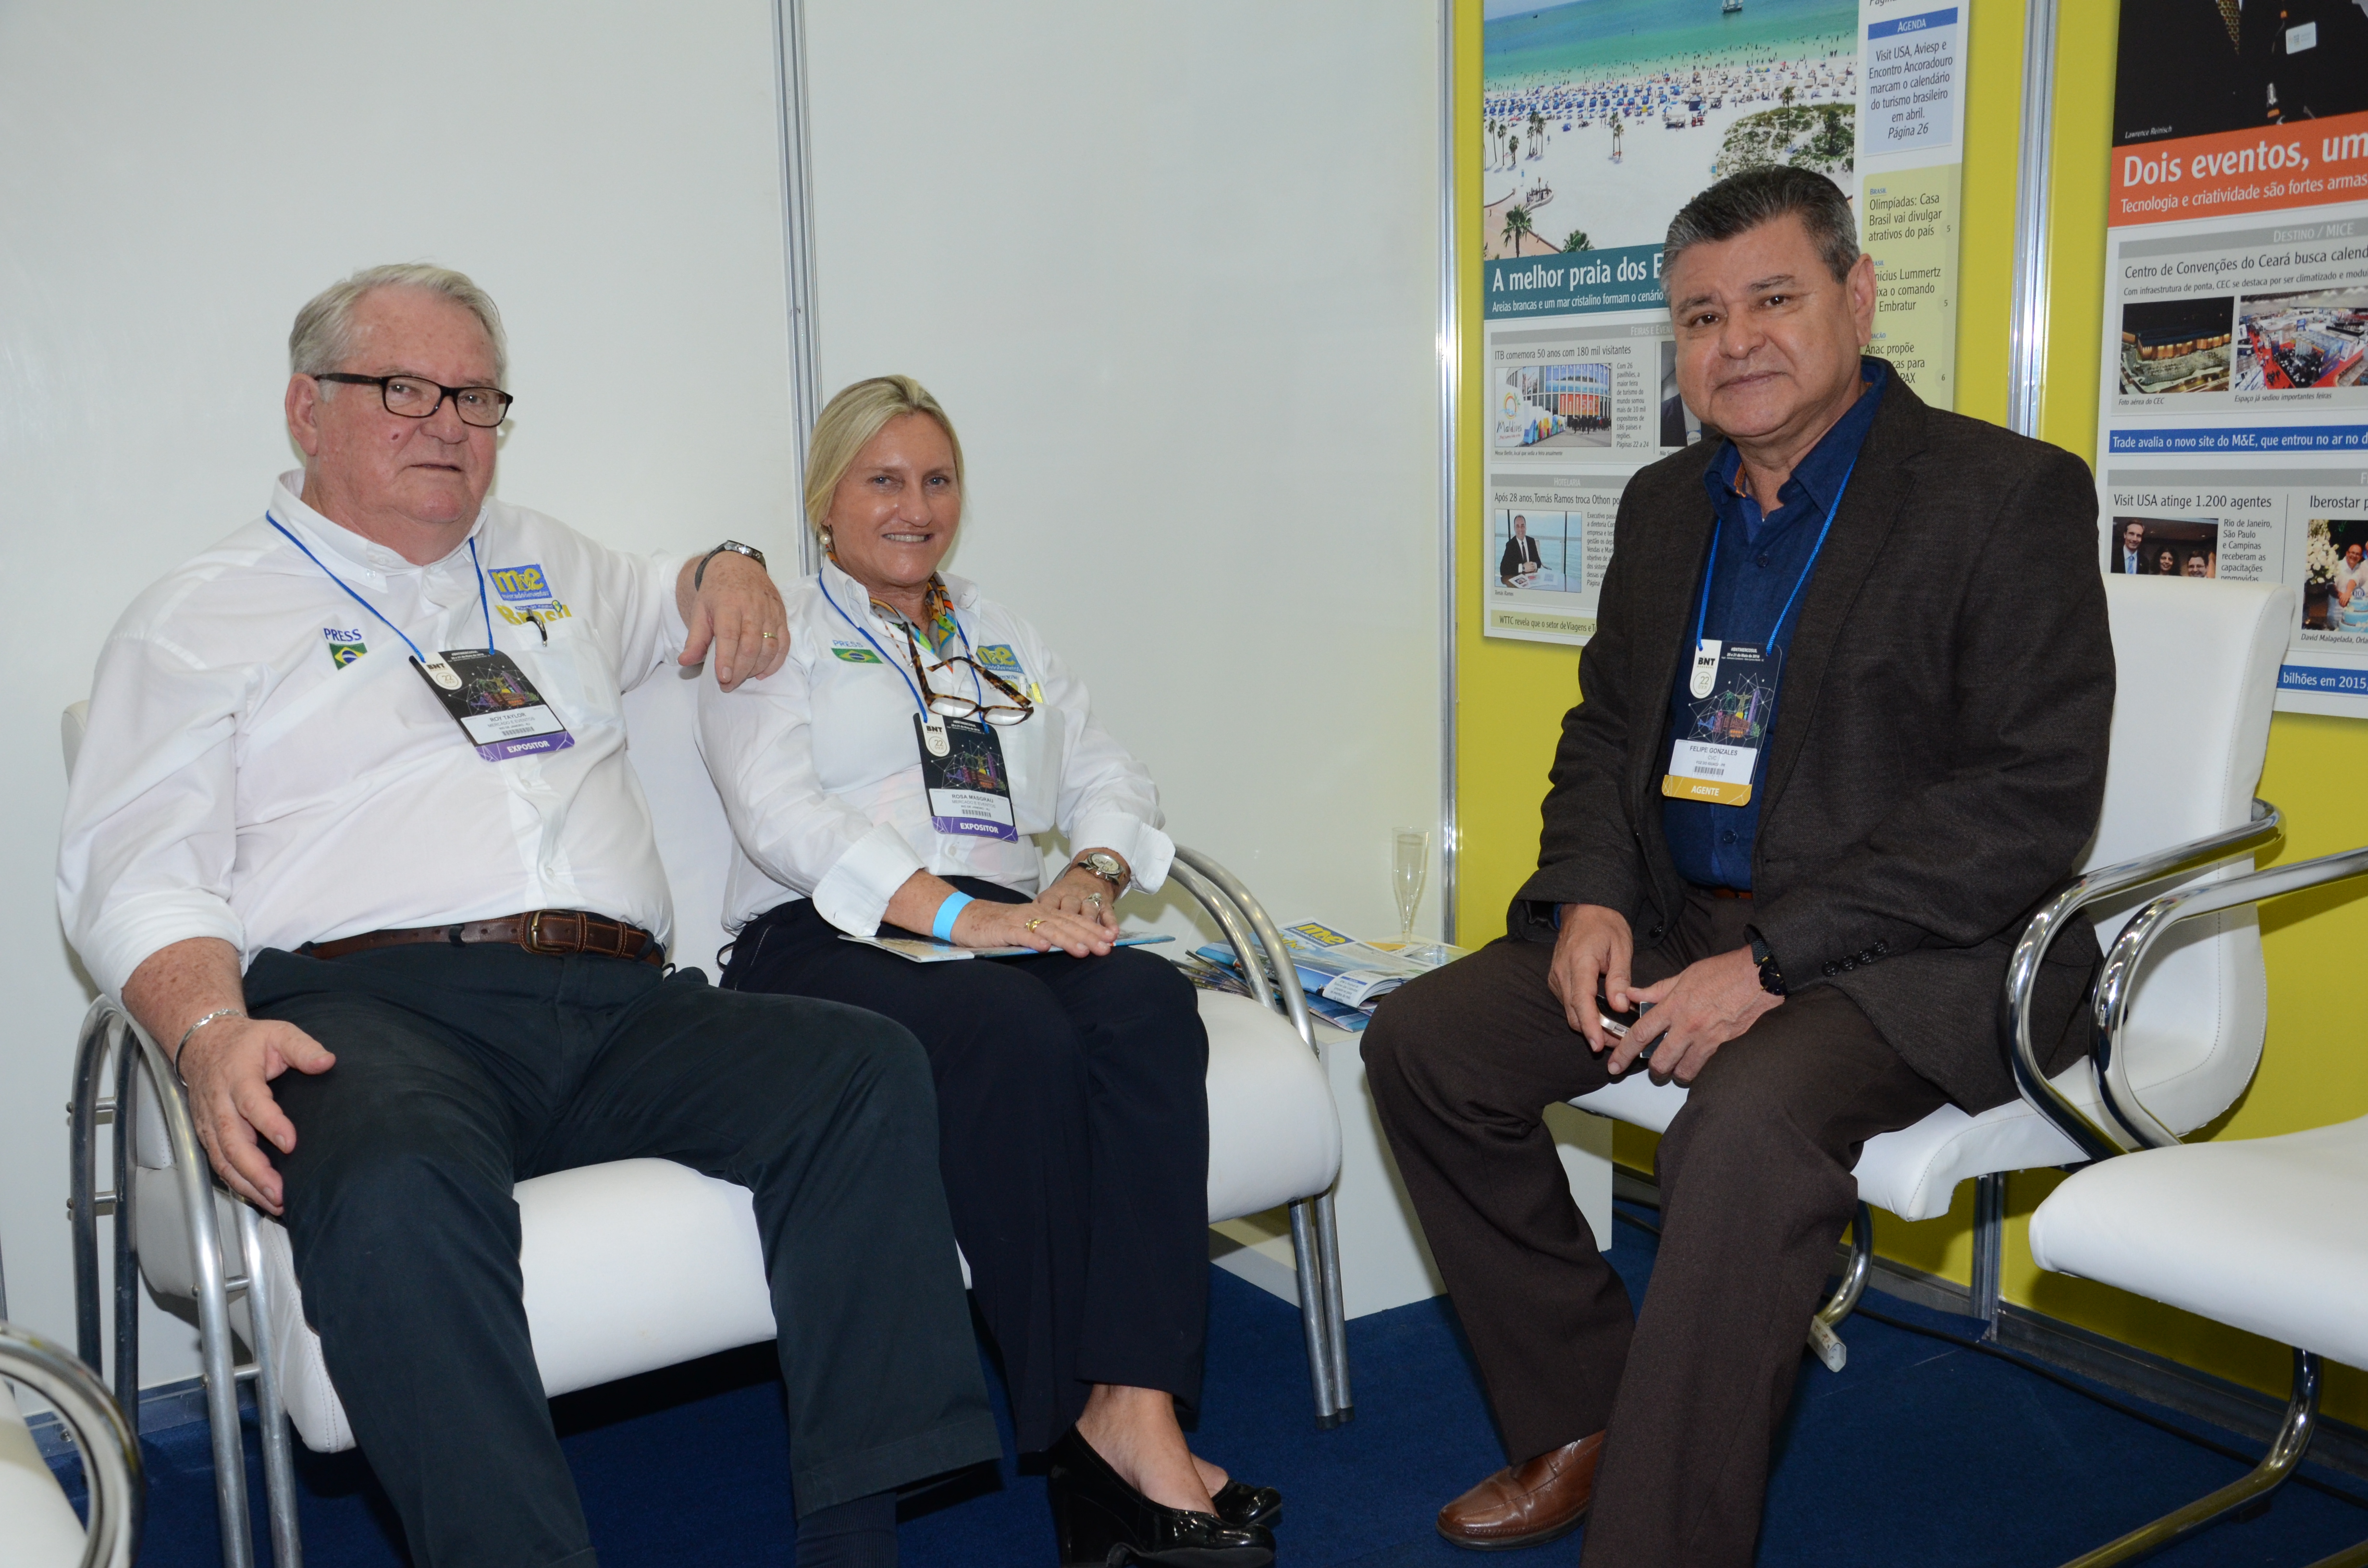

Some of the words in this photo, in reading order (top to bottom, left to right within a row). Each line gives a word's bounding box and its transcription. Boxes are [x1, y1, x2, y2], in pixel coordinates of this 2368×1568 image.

[1898, 19, 1926, 32] AGENDA
[1876, 49, 1891, 61] Visit
[1894, 46, 1912, 59] USA,
[1914, 42, 1939, 55] Aviesp
[1869, 65, 1901, 79] Encontro
[1904, 57, 1953, 73] Ancoradouro
[1871, 82, 1900, 95] marcam
[1911, 72, 1950, 88] calendário
[1871, 99, 1880, 110] do
[1883, 95, 1910, 108] turismo
[1913, 90, 1948, 103] brasileiro
[1892, 112, 1903, 122] em
[1906, 108, 1925, 121] abril.
[1888, 126, 1914, 140] Página
[1917, 123, 1929, 135] 26
[2123, 152, 2182, 187] Dois
[2191, 140, 2309, 179] eventos,
[2121, 195, 2178, 213] Tecnologia
[2192, 184, 2259, 206] criatividade
[2263, 182, 2284, 197] são
[2289, 179, 2323, 195] fortes
[2328, 174, 2367, 190] armas
[1870, 196, 1917, 211] Olimpíadas:
[1920, 193, 1939, 205] Casa
[1870, 213, 1890, 226] Brasil
[1894, 212, 1905, 223] vai
[1908, 209, 1942, 222] divulgar
[1869, 229, 1902, 241] atrativos
[1905, 227, 1914, 238] do
[1918, 224, 1934, 239] país
[2273, 229, 2314, 242] DESTINO
[2327, 222, 2354, 236] MICE
[2125, 266, 2157, 279] Centro
[2161, 263, 2172, 276] de
[2177, 258, 2237, 275] Convenções
[2242, 257, 2254, 269] do
[2259, 252, 2290, 267] Ceará
[2295, 252, 2326, 264] busca
[1492, 268, 1504, 292] A
[1510, 265, 1564, 290] melhor
[1570, 259, 1611, 291] praia
[1617, 257, 1646, 282] dos
[1900, 267, 1941, 280] Lummertz
[1898, 282, 1935, 295] comando
[2124, 288, 2137, 296] Com
[2140, 286, 2182, 294] infraestrutura
[2194, 283, 2214, 293] ponta,
[2217, 280, 2230, 289] CEC
[2242, 278, 2267, 287] destaca
[2270, 278, 2281, 286] por
[2296, 272, 2336, 283] climatizado
[1492, 301, 1511, 312] Areias
[1513, 300, 1537, 311] brancas
[1545, 300, 1554, 308] um
[1557, 298, 1570, 307] mar
[1572, 294, 1601, 306] cristalino
[1603, 293, 1629, 305] formam
[1638, 289, 1663, 302] cenário
[1879, 300, 1916, 312] Embratur
[1495, 351, 1504, 360] ITB
[1506, 351, 1535, 359] comemora
[1538, 349, 1545, 358] 50
[1547, 350, 1561, 358] anos
[1577, 347, 1589, 356] 180
[1591, 346, 1600, 355] mil
[1603, 345, 1631, 355] visitantes
[2255, 394, 2260, 403] já
[2282, 392, 2314, 402] importantes
[2113, 437, 2135, 448] Trade
[2138, 436, 2163, 447] avalia
[2175, 439, 2196, 447] novo
[2199, 436, 2214, 447] site
[2218, 435, 2229, 446] do
[2232, 434, 2257, 447] M&E,
[2261, 436, 2278, 448] que
[2282, 435, 2313, 445] entrou
[2317, 435, 2329, 444] no
[2332, 435, 2343, 444] ar
[2346, 435, 2358, 444] no
[1554, 478, 1580, 487] HOTELARIA
[1495, 492, 1508, 503] Após
[1510, 493, 1517, 502] 28
[1519, 495, 1533, 503] anos,
[1534, 493, 1552, 503] Tomás
[1554, 494, 1574, 503] Ramos
[1576, 495, 1590, 504] troca
[1592, 495, 1610, 504] Othon
[2114, 494, 2134, 506] Visit
[2137, 494, 2157, 506] USA
[2161, 495, 2191, 509] atinge
[2196, 496, 2227, 507] 1.200
[2230, 496, 2271, 510] agentes
[2310, 495, 2360, 508] Iberostar
[2224, 519, 2234, 527] Rio
[2247, 520, 2272, 528] Janeiro,
[2229, 541, 2261, 551] Campinas
[2221, 564, 2262, 574] capacitações
[1500, 615, 1513, 624] WTTC
[1515, 618, 1529, 626] revela
[1566, 622, 1586, 632] Viagens
[324, 628, 362, 642] PRESS
[2319, 635, 2354, 643] Malagelada,
[1701, 676, 1709, 685] 22
[2283, 673, 2317, 685] bilhões
[2320, 677, 2335, 686] em
[507, 741, 550, 753] EXPOSITOR
[1691, 785, 1720, 796] AGENTE
[960, 823, 999, 833] EXPOSITOR
